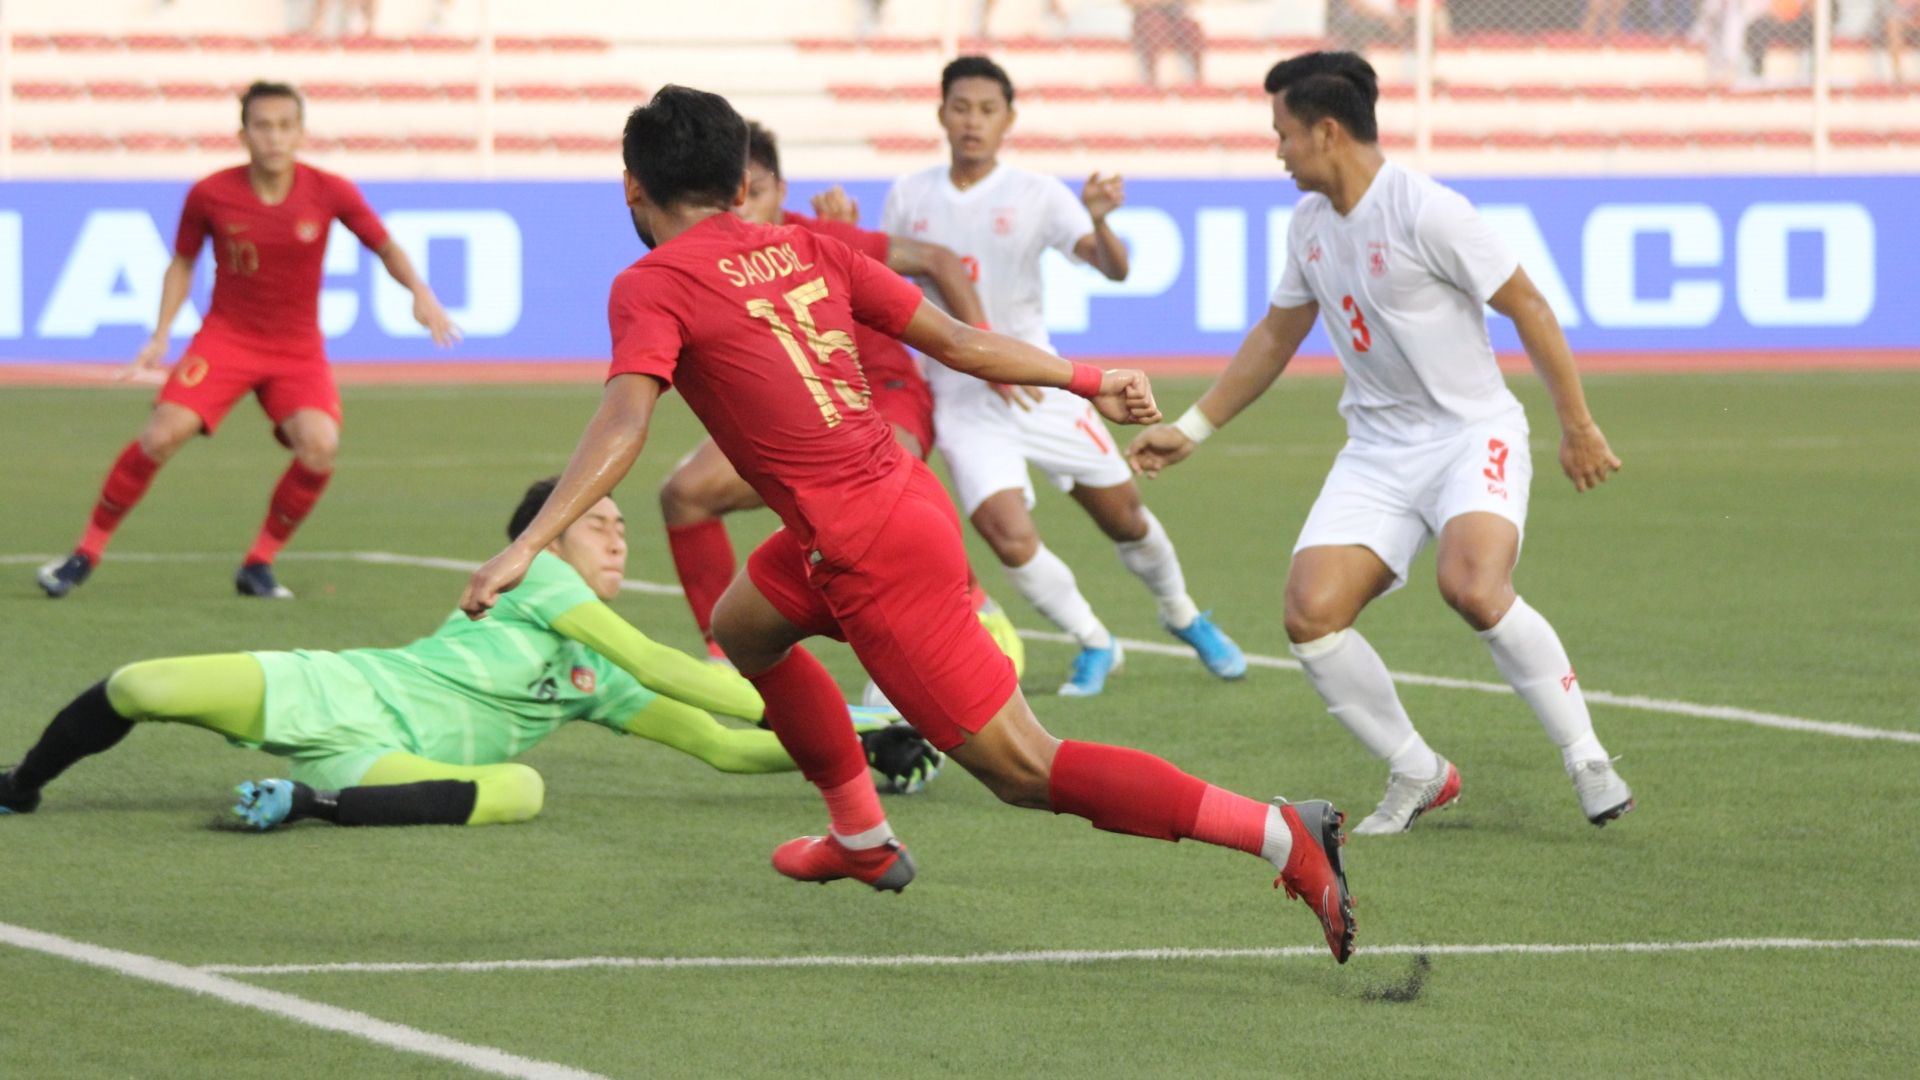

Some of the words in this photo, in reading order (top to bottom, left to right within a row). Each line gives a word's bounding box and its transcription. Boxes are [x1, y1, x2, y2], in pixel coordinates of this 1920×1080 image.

[0, 210, 523, 338] AO
[226, 238, 260, 277] 10
[1040, 202, 1876, 332] PICO
[746, 275, 871, 428] 15
[1342, 294, 1372, 353] 3
[1483, 438, 1509, 482] 3
